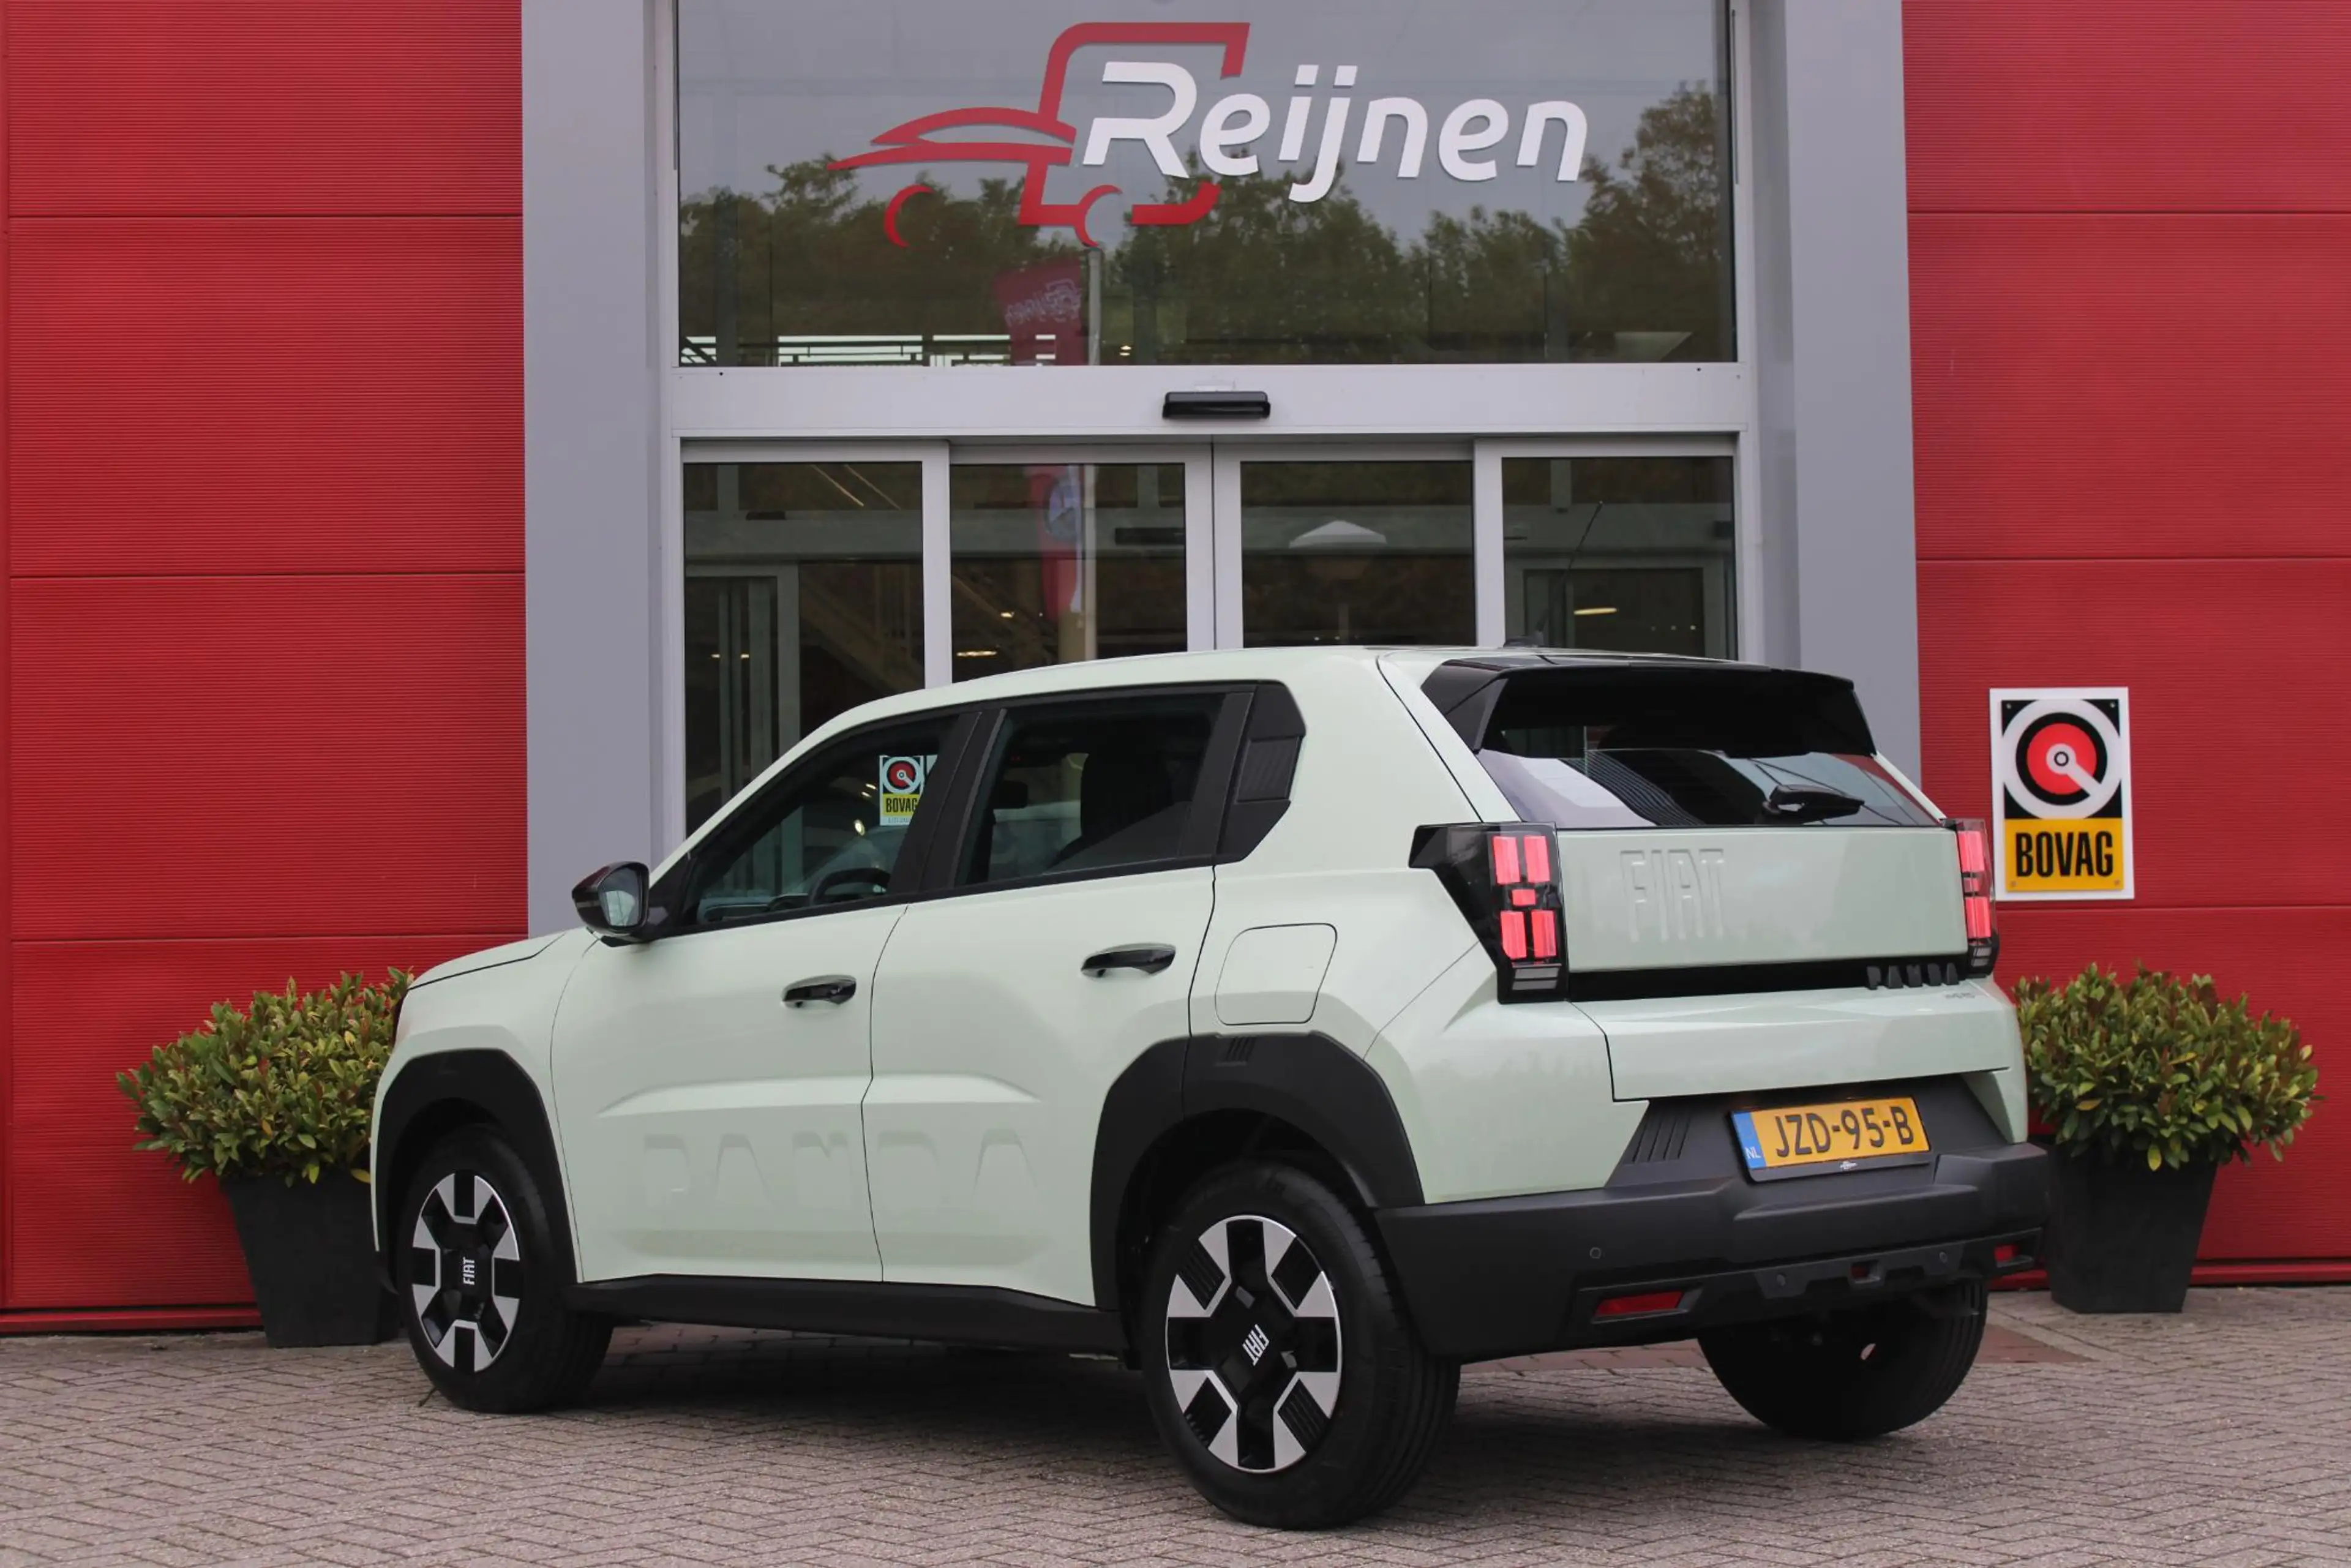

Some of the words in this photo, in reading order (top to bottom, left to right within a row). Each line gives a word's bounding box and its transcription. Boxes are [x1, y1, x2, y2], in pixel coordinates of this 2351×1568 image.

[1082, 61, 1588, 203] Reijnen
[2015, 831, 2113, 877] BOVAG
[1619, 847, 1724, 943] FIAT
[1745, 1147, 1761, 1160] NL
[1774, 1106, 1914, 1157] JZD-95-B
[462, 1256, 475, 1286] FIAT
[1242, 1324, 1270, 1367] FIAT
